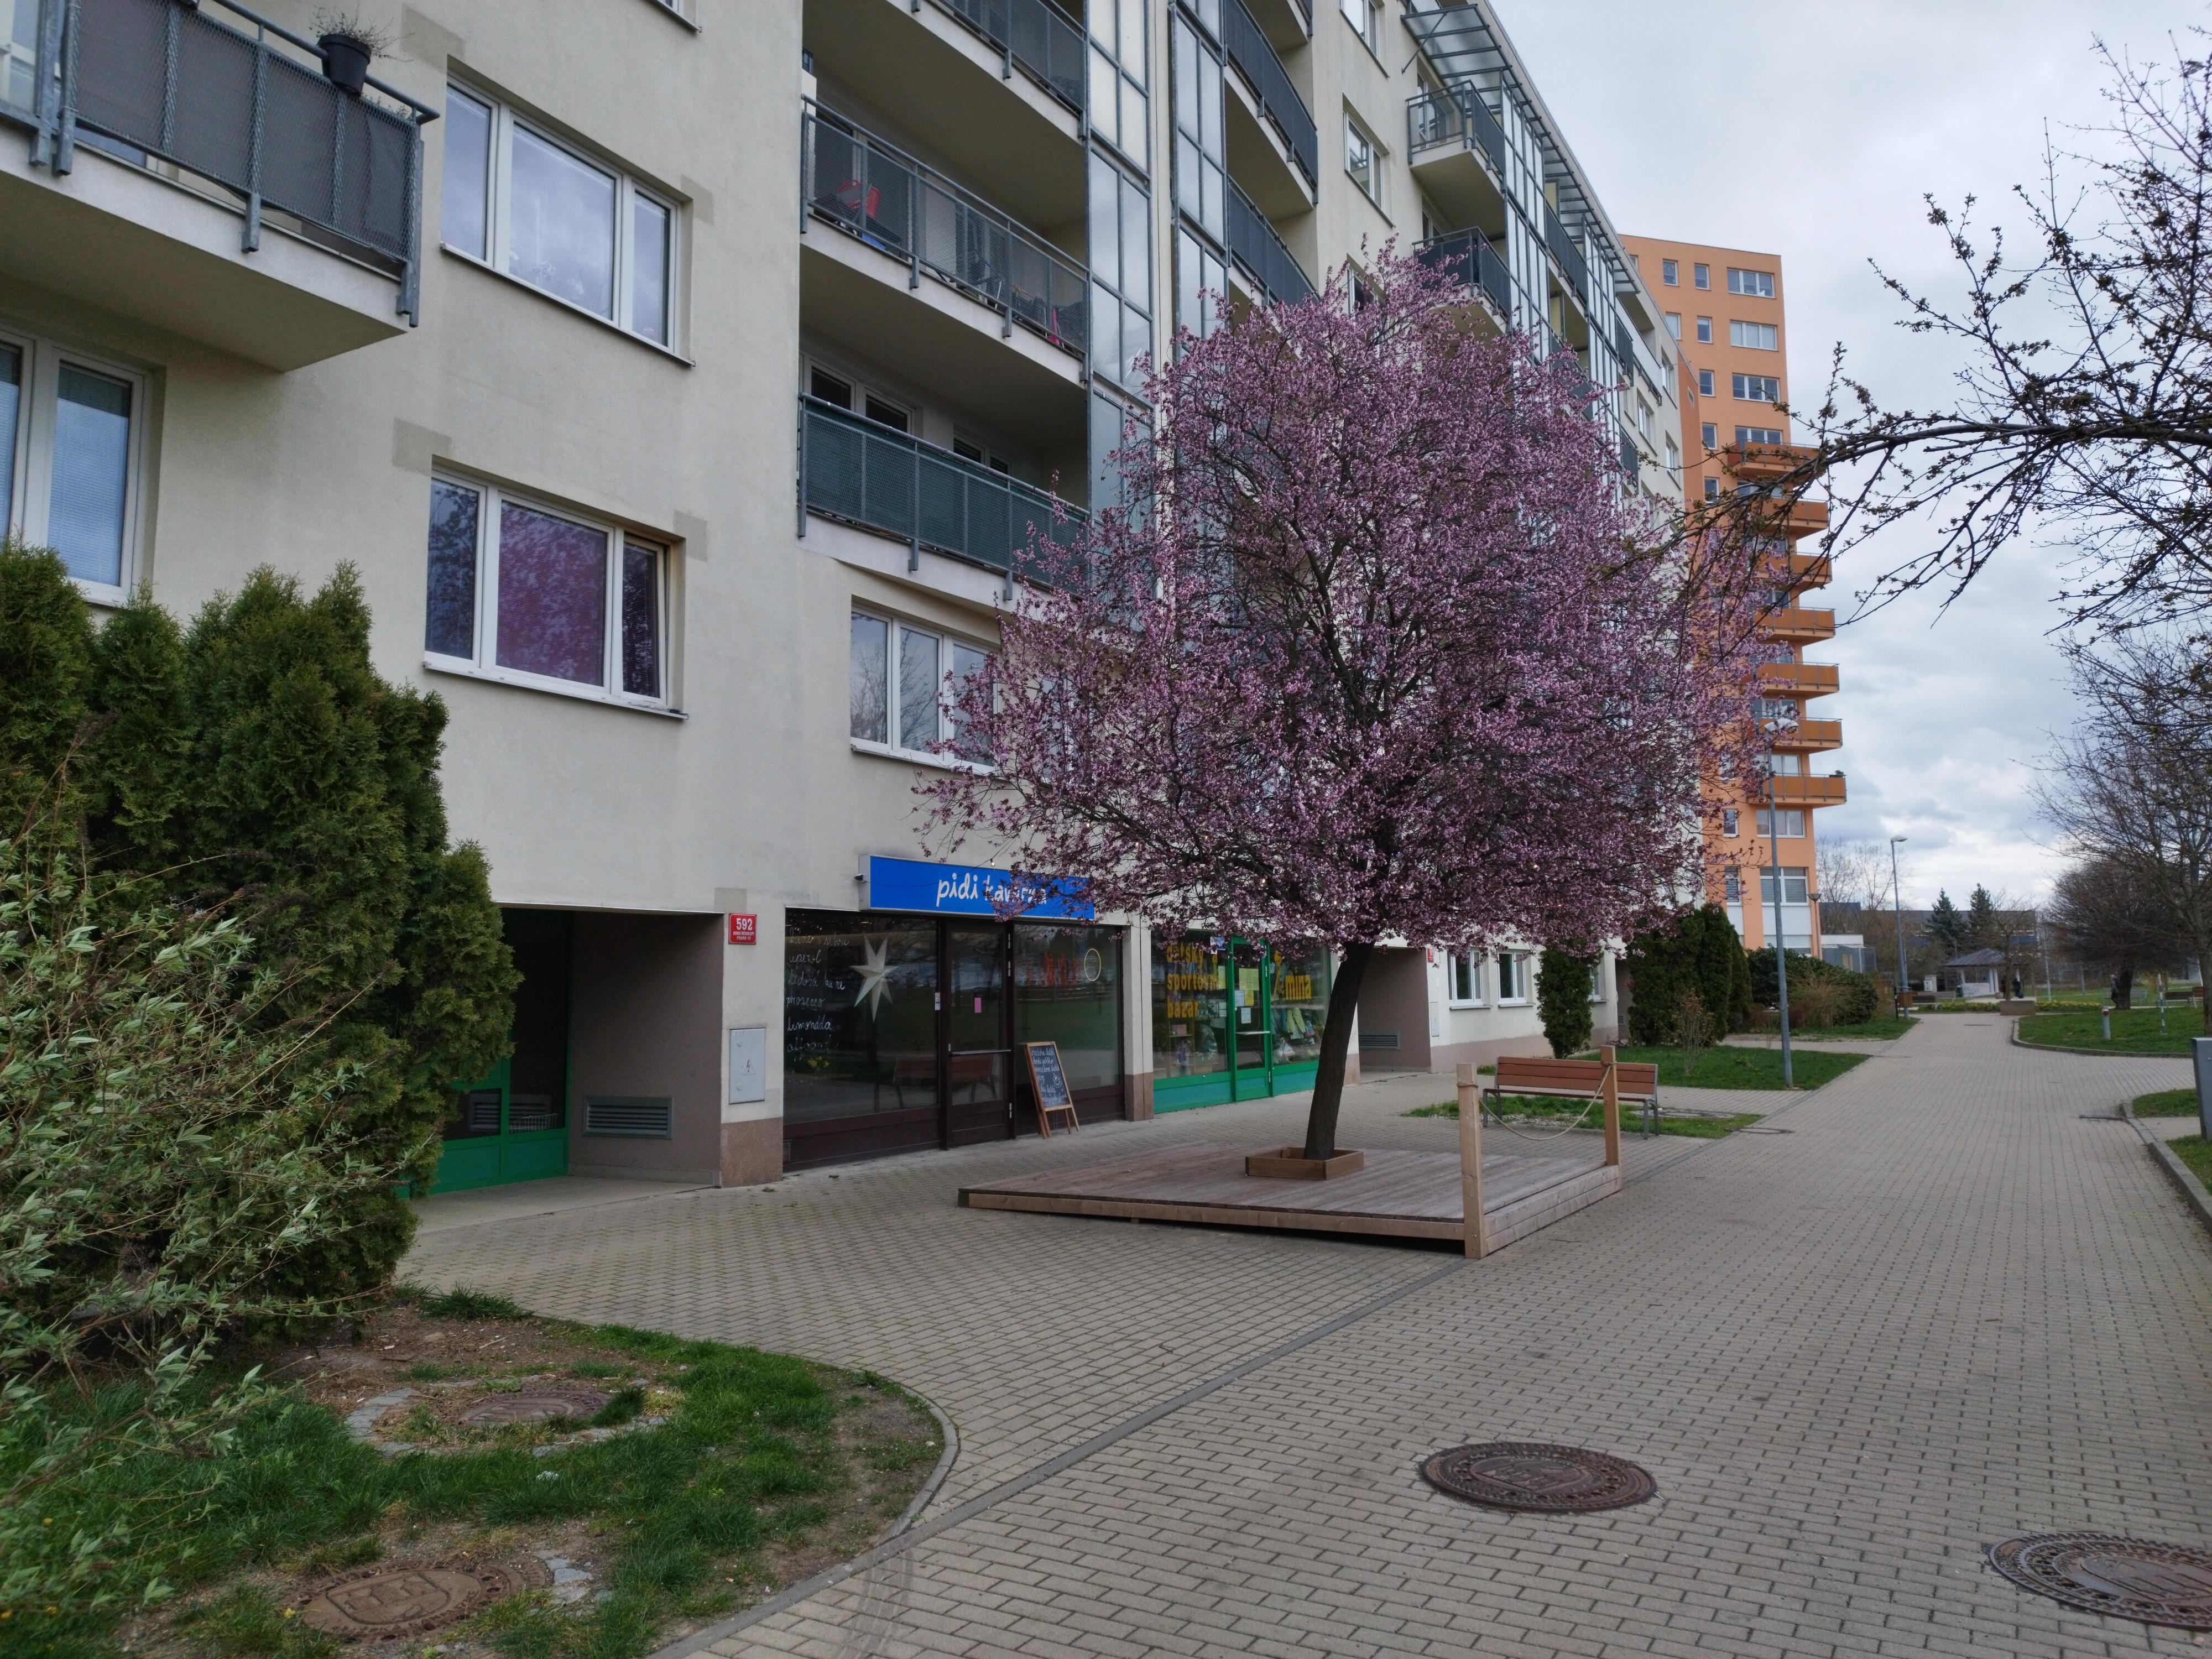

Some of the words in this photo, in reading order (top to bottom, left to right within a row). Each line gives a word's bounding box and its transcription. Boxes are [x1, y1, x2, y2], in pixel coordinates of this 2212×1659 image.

[936, 872, 978, 907] pidi
[736, 918, 753, 930] 592
[786, 997, 825, 1009] prosecco
[1167, 995, 1199, 1018] bazar
